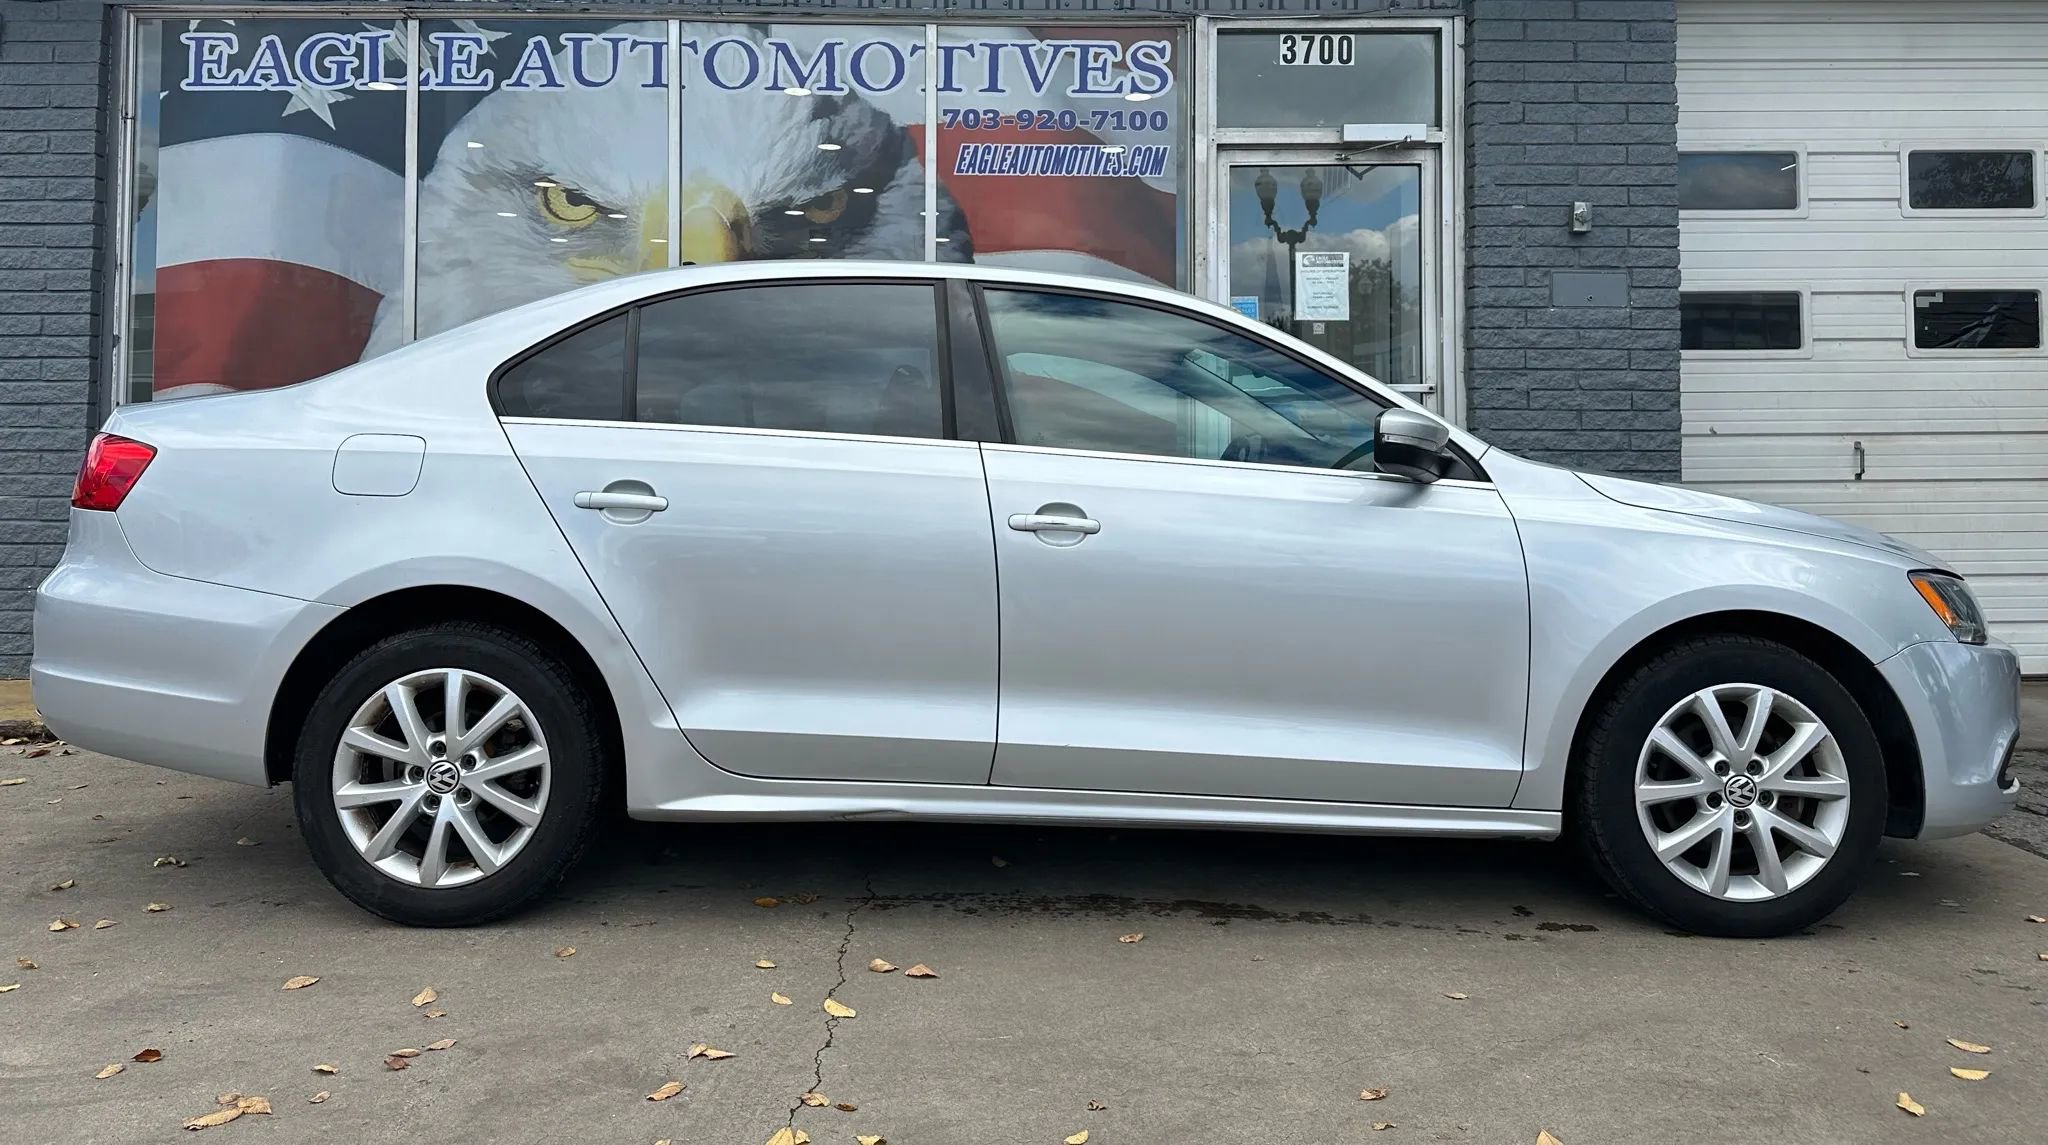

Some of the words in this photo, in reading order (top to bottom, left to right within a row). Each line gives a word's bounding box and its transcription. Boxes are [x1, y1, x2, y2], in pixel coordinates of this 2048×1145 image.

[182, 33, 493, 91] EAGLE
[503, 34, 1171, 96] AUTOMOTIVES
[1282, 35, 1352, 64] 3700
[942, 108, 1169, 131] 703-920-7100
[955, 143, 1168, 177] EAGLEAUTOMOTIVES.COM
